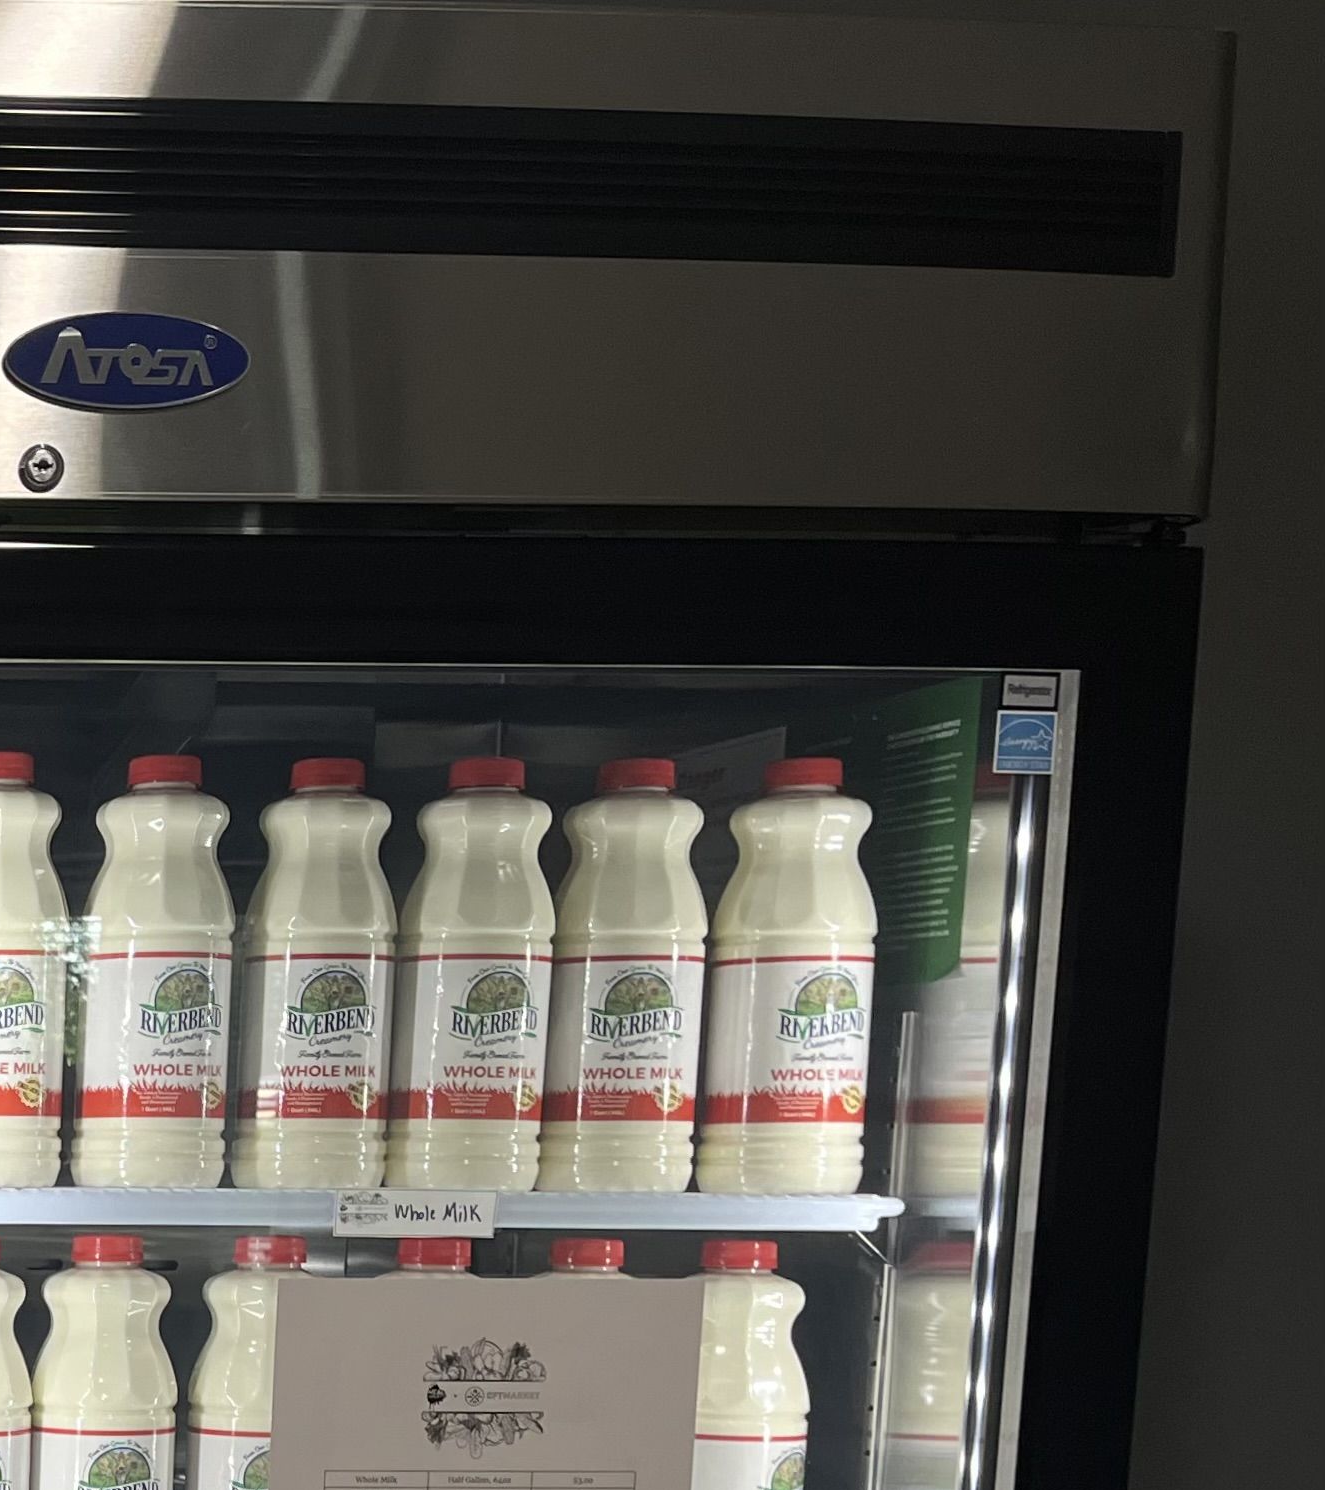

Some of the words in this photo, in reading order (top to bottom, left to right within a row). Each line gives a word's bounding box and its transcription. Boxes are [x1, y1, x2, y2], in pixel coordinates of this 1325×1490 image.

[41, 326, 213, 386] ATOSA
[140, 1003, 222, 1034] RIVERBEND
[287, 1008, 375, 1036] RIVERBEND
[452, 1009, 537, 1037] RIVERBEND
[591, 1010, 682, 1038] RIVERBEND
[780, 1011, 865, 1039] RIVERBEND
[15, 1062, 45, 1075] MILK
[134, 1063, 193, 1076] WHOLE
[198, 1064, 222, 1076] MILK
[281, 1065, 341, 1077] WHOLE
[344, 1065, 375, 1078] MILK
[444, 1065, 505, 1078] WHOLE
[511, 1066, 537, 1079] MILK
[582, 1067, 646, 1080] WHOLE
[650, 1067, 683, 1081] MILK
[771, 1068, 834, 1081] WHOLE
[838, 1068, 864, 1081] MILK
[395, 1203, 435, 1221] Whole
